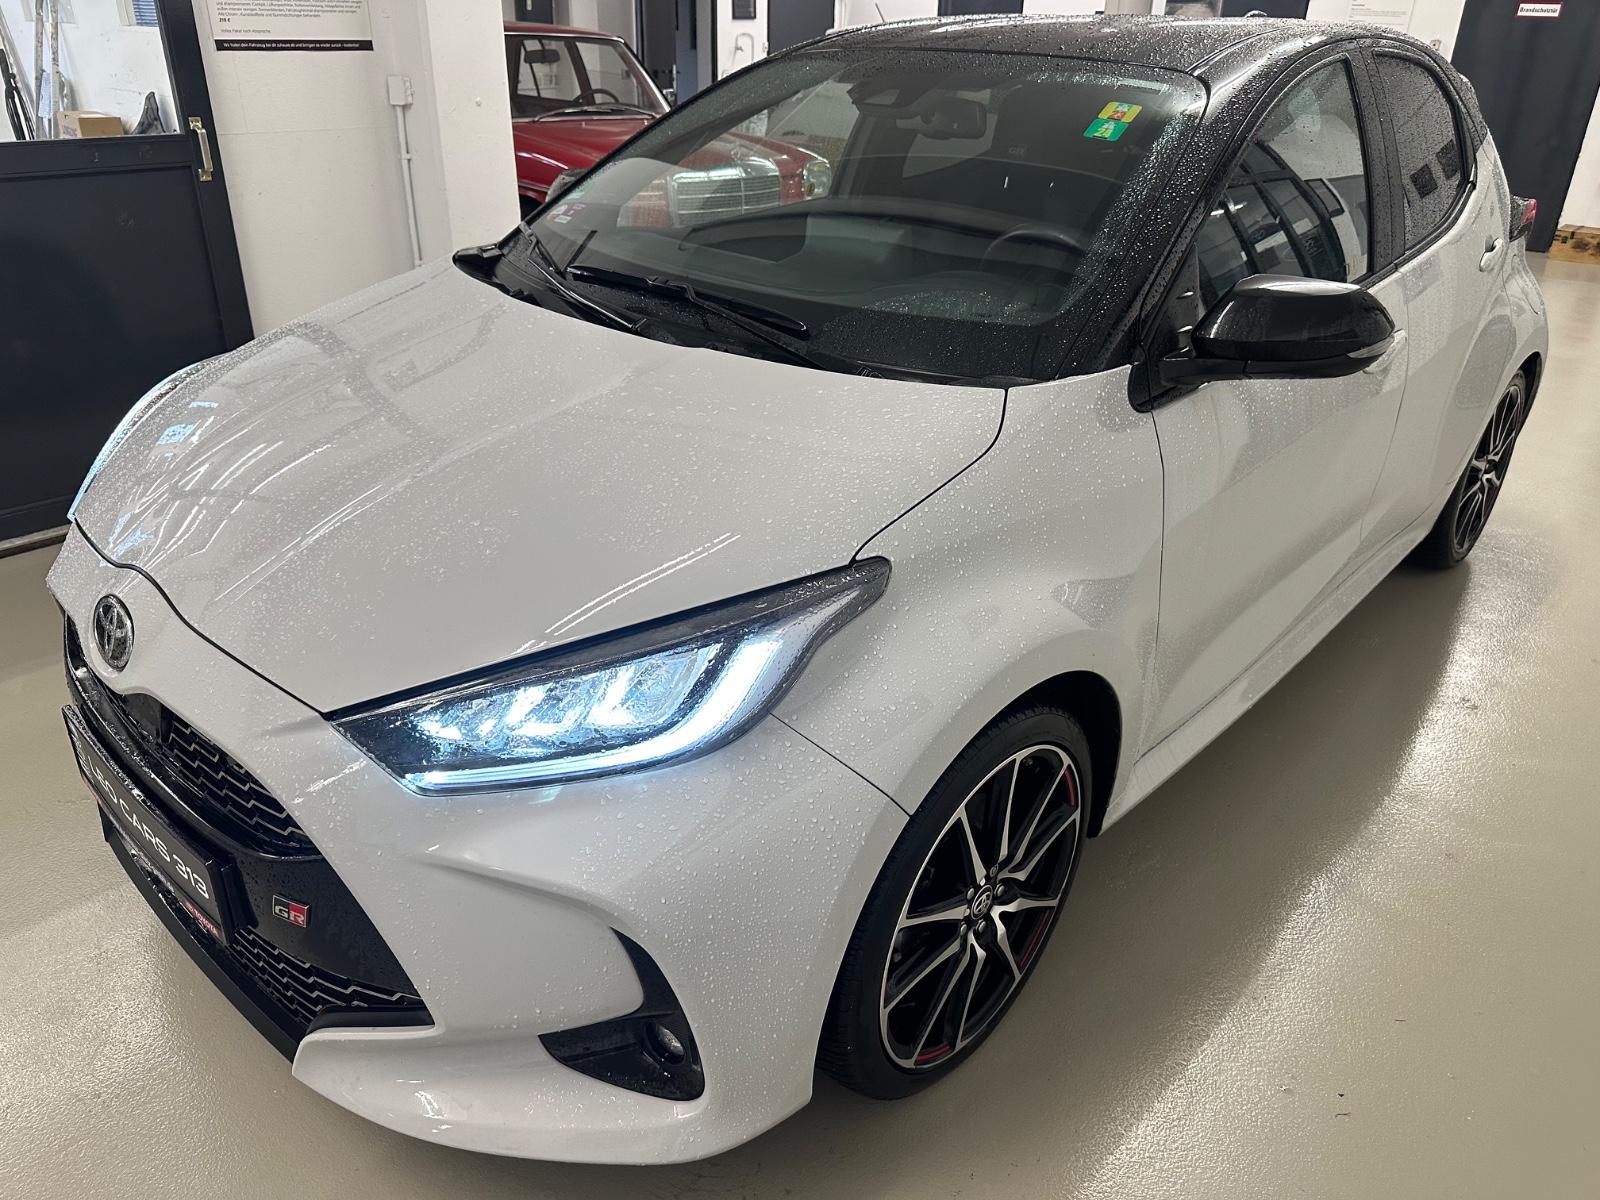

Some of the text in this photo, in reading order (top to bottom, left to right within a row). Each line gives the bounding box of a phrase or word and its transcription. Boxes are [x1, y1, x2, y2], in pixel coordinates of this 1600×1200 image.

[88, 755, 210, 899] LEO CARS 313
[274, 905, 306, 926] GR
